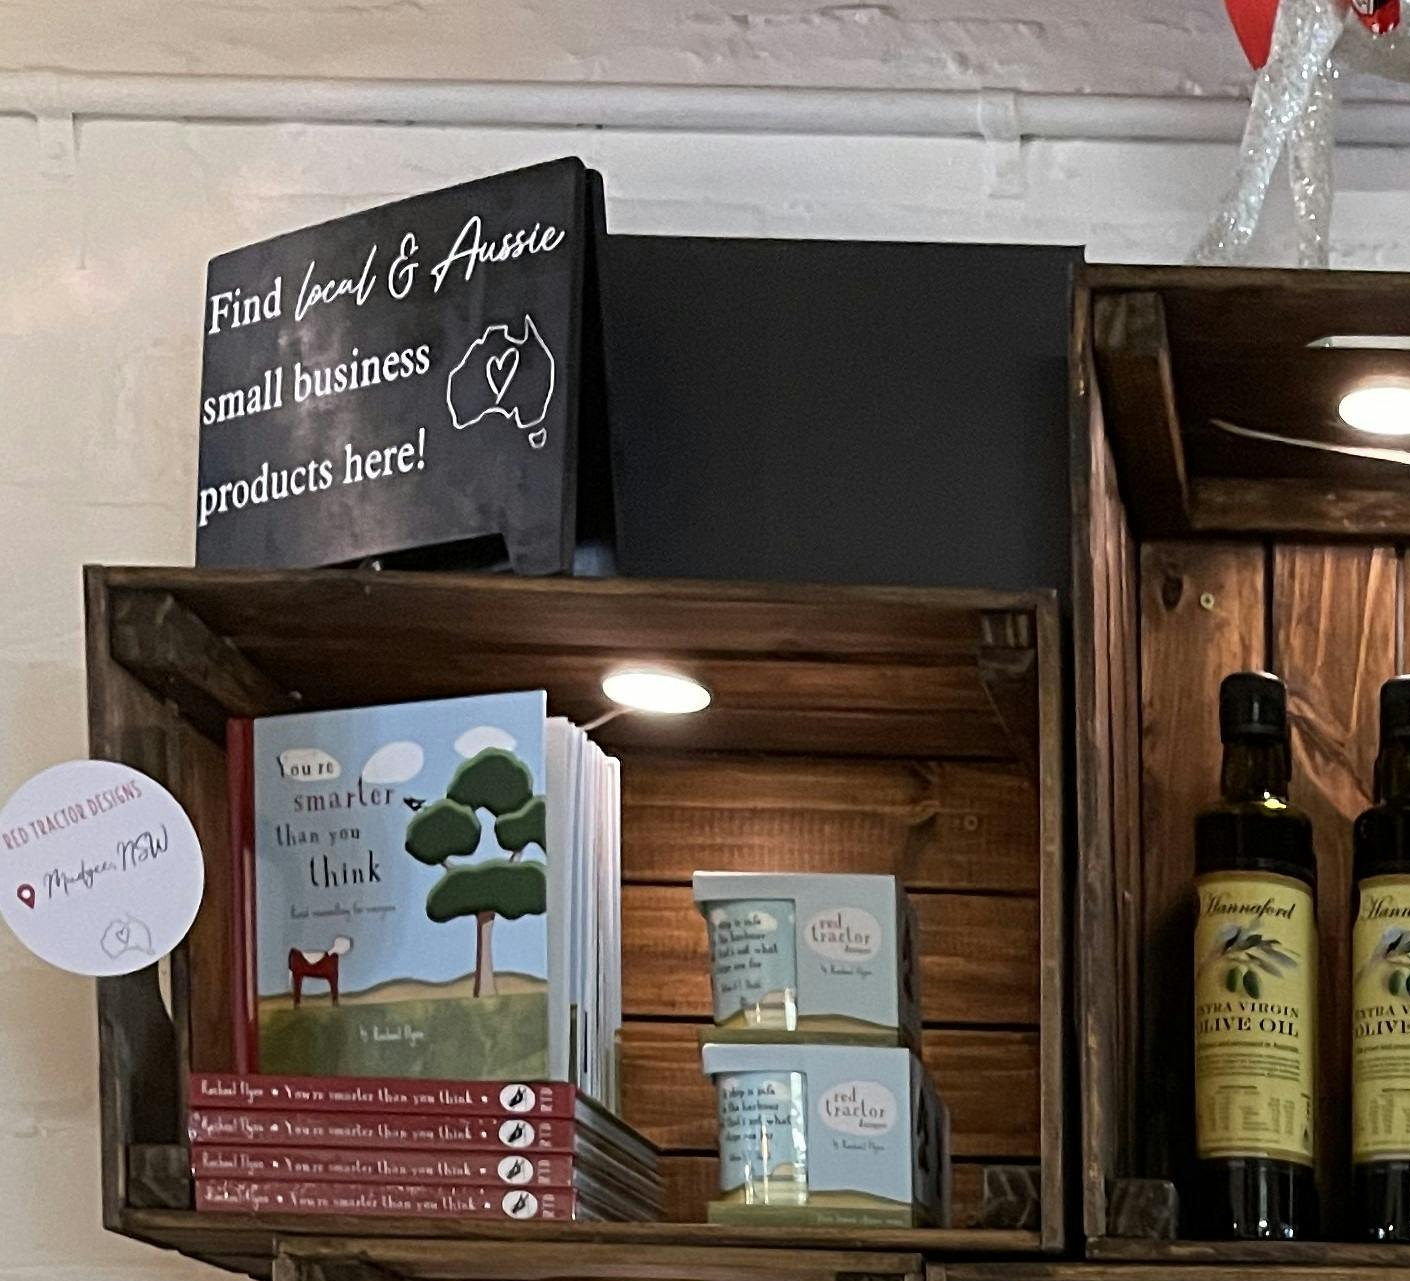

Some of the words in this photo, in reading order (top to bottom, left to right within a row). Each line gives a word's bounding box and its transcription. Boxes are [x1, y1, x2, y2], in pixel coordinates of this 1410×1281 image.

[208, 278, 281, 334] Find
[295, 245, 377, 320] local
[388, 234, 419, 299] &
[432, 217, 565, 292] Aussie
[204, 369, 283, 424] small
[295, 344, 430, 402] business
[198, 461, 333, 525] products
[344, 428, 426, 469] here!
[276, 756, 334, 778] Youre
[294, 776, 394, 812] smarter
[3, 828, 29, 849] RED
[32, 804, 87, 840] TRACTOR
[87, 780, 142, 817] DESIGNS
[276, 823, 319, 846] than
[329, 828, 360, 845] you
[117, 825, 168, 871] NSW
[310, 850, 381, 888] think
[1202, 894, 1296, 920] Hannaford
[820, 912, 841, 929] red
[812, 924, 870, 943] tractor
[1240, 1002, 1298, 1018] VIRGIN
[1260, 1018, 1298, 1037] OIL
[834, 1087, 856, 1103] red
[826, 1100, 885, 1118] tractor
